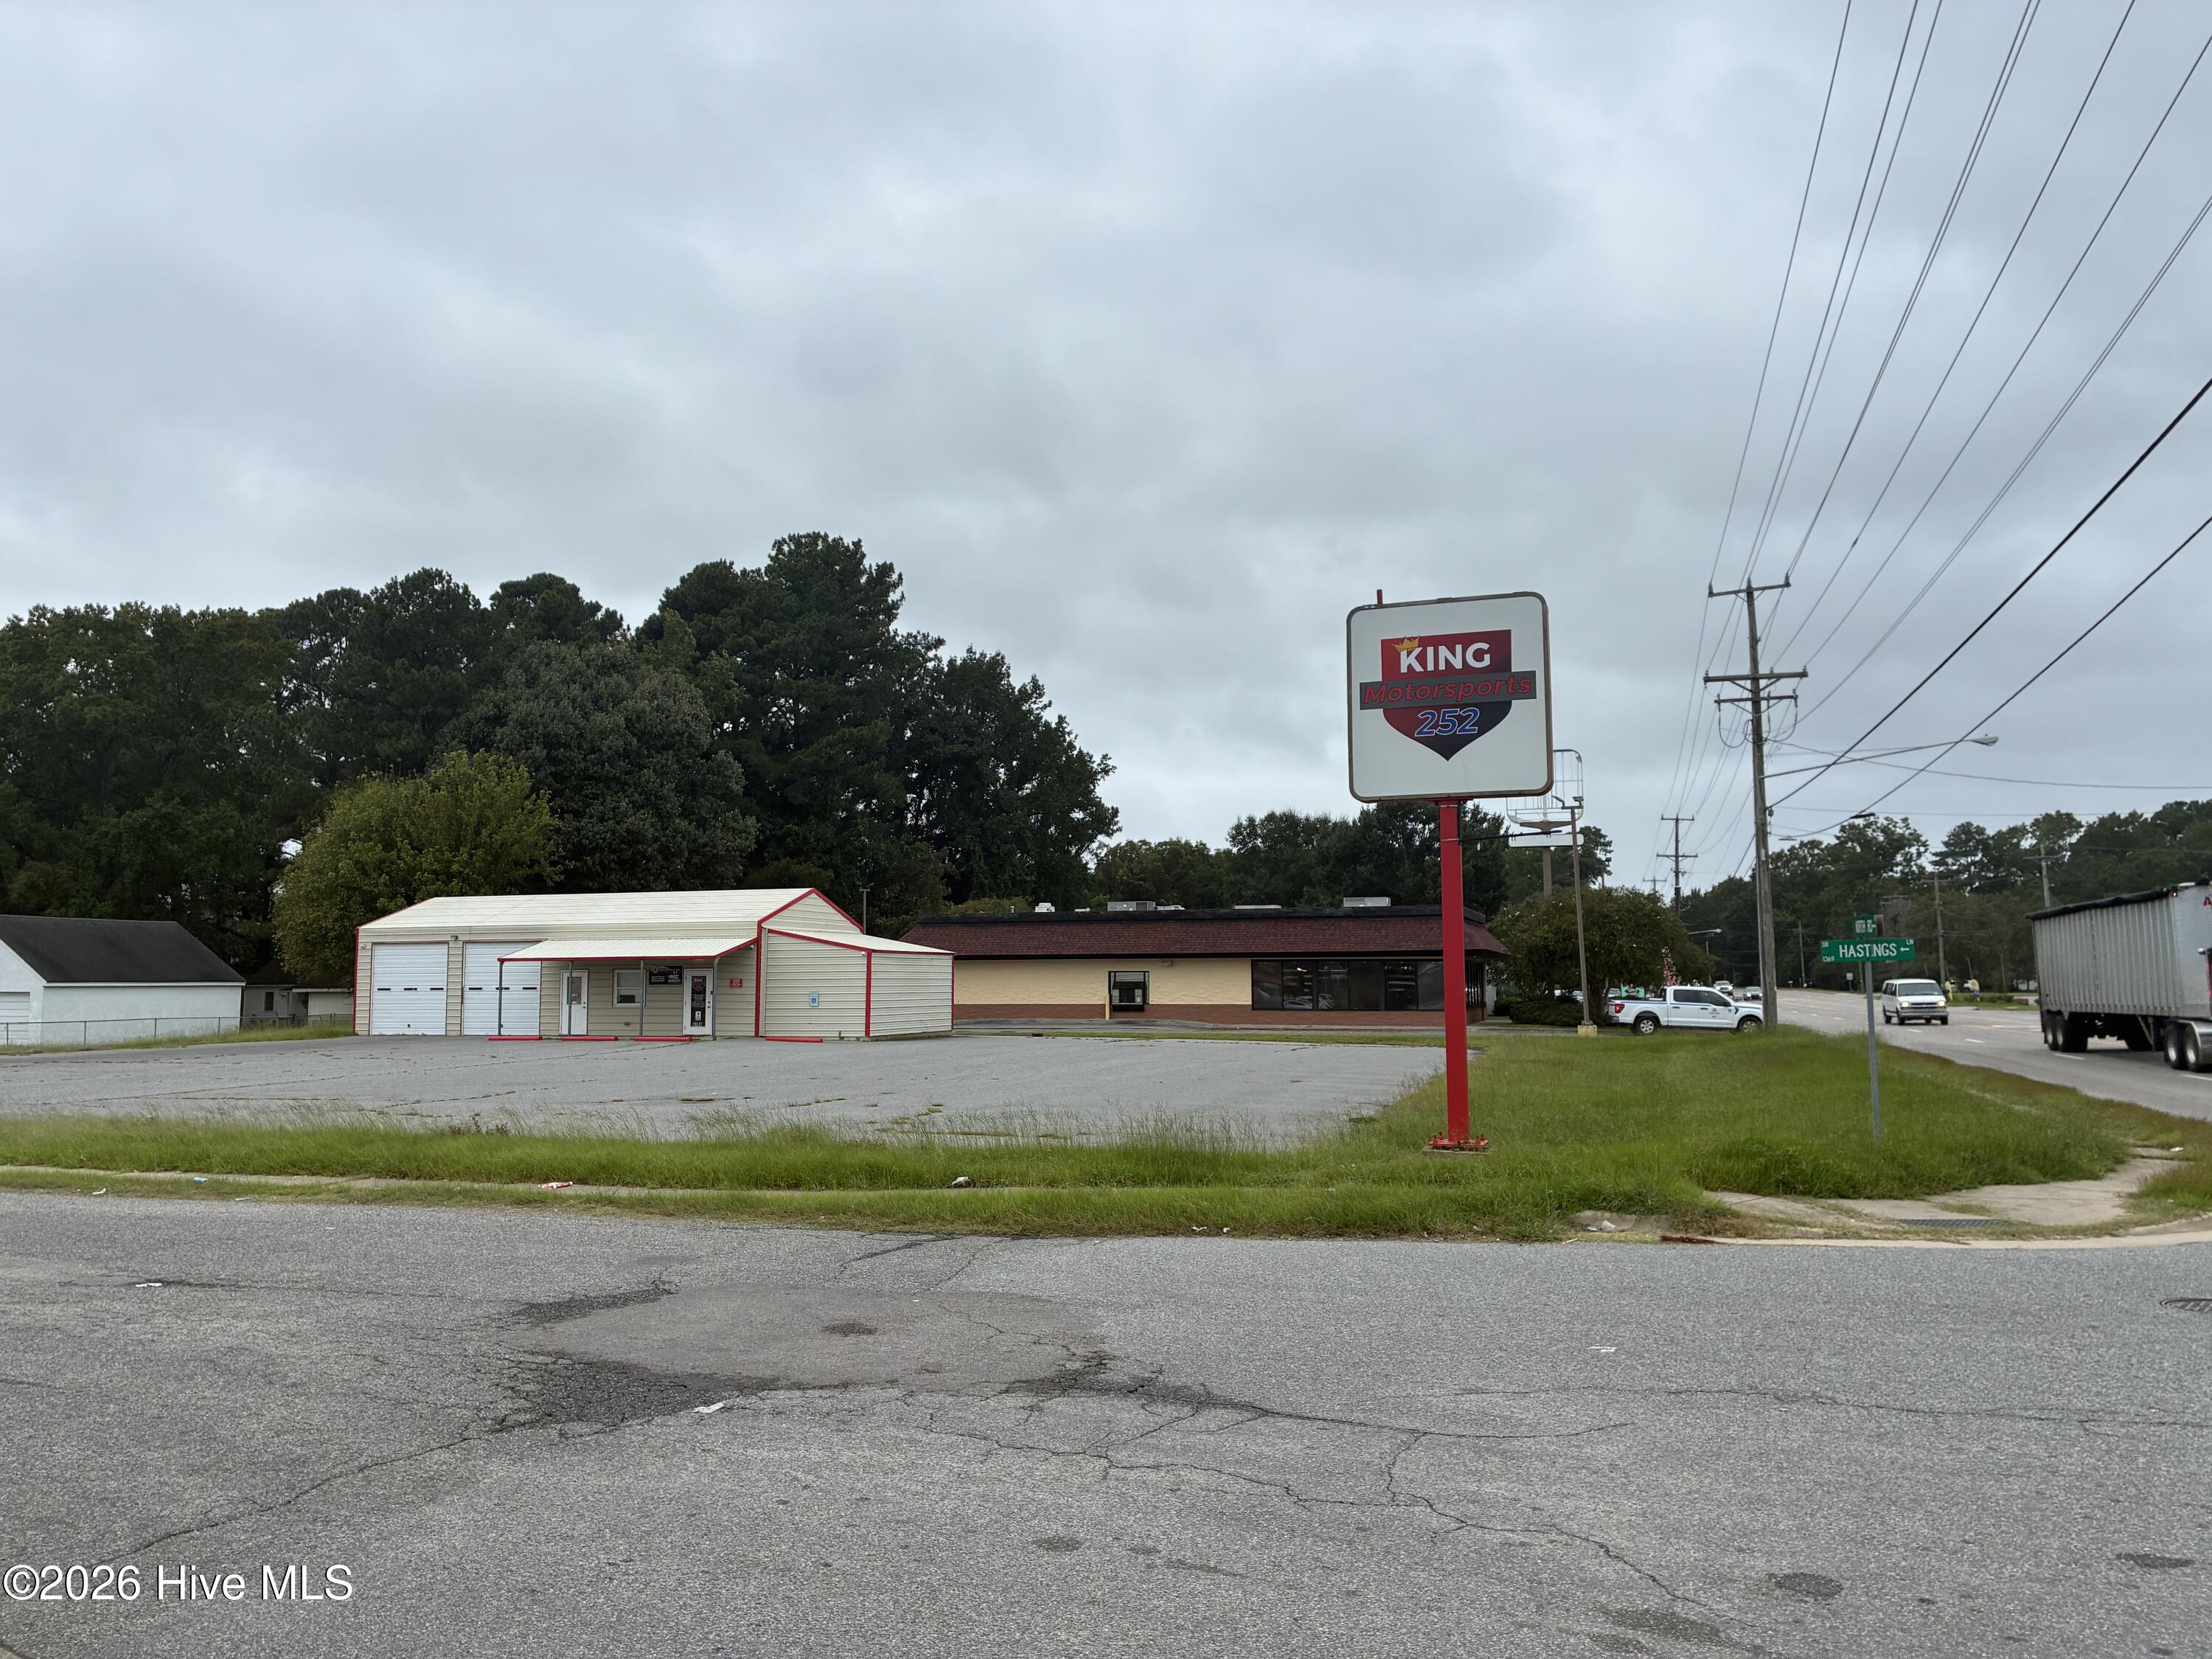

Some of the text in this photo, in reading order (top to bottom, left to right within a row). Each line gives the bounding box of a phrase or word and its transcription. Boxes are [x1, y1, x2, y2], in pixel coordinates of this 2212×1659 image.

[1400, 642, 1491, 673] KING
[1364, 676, 1531, 703] Motorsports
[1415, 707, 1480, 737] 252
